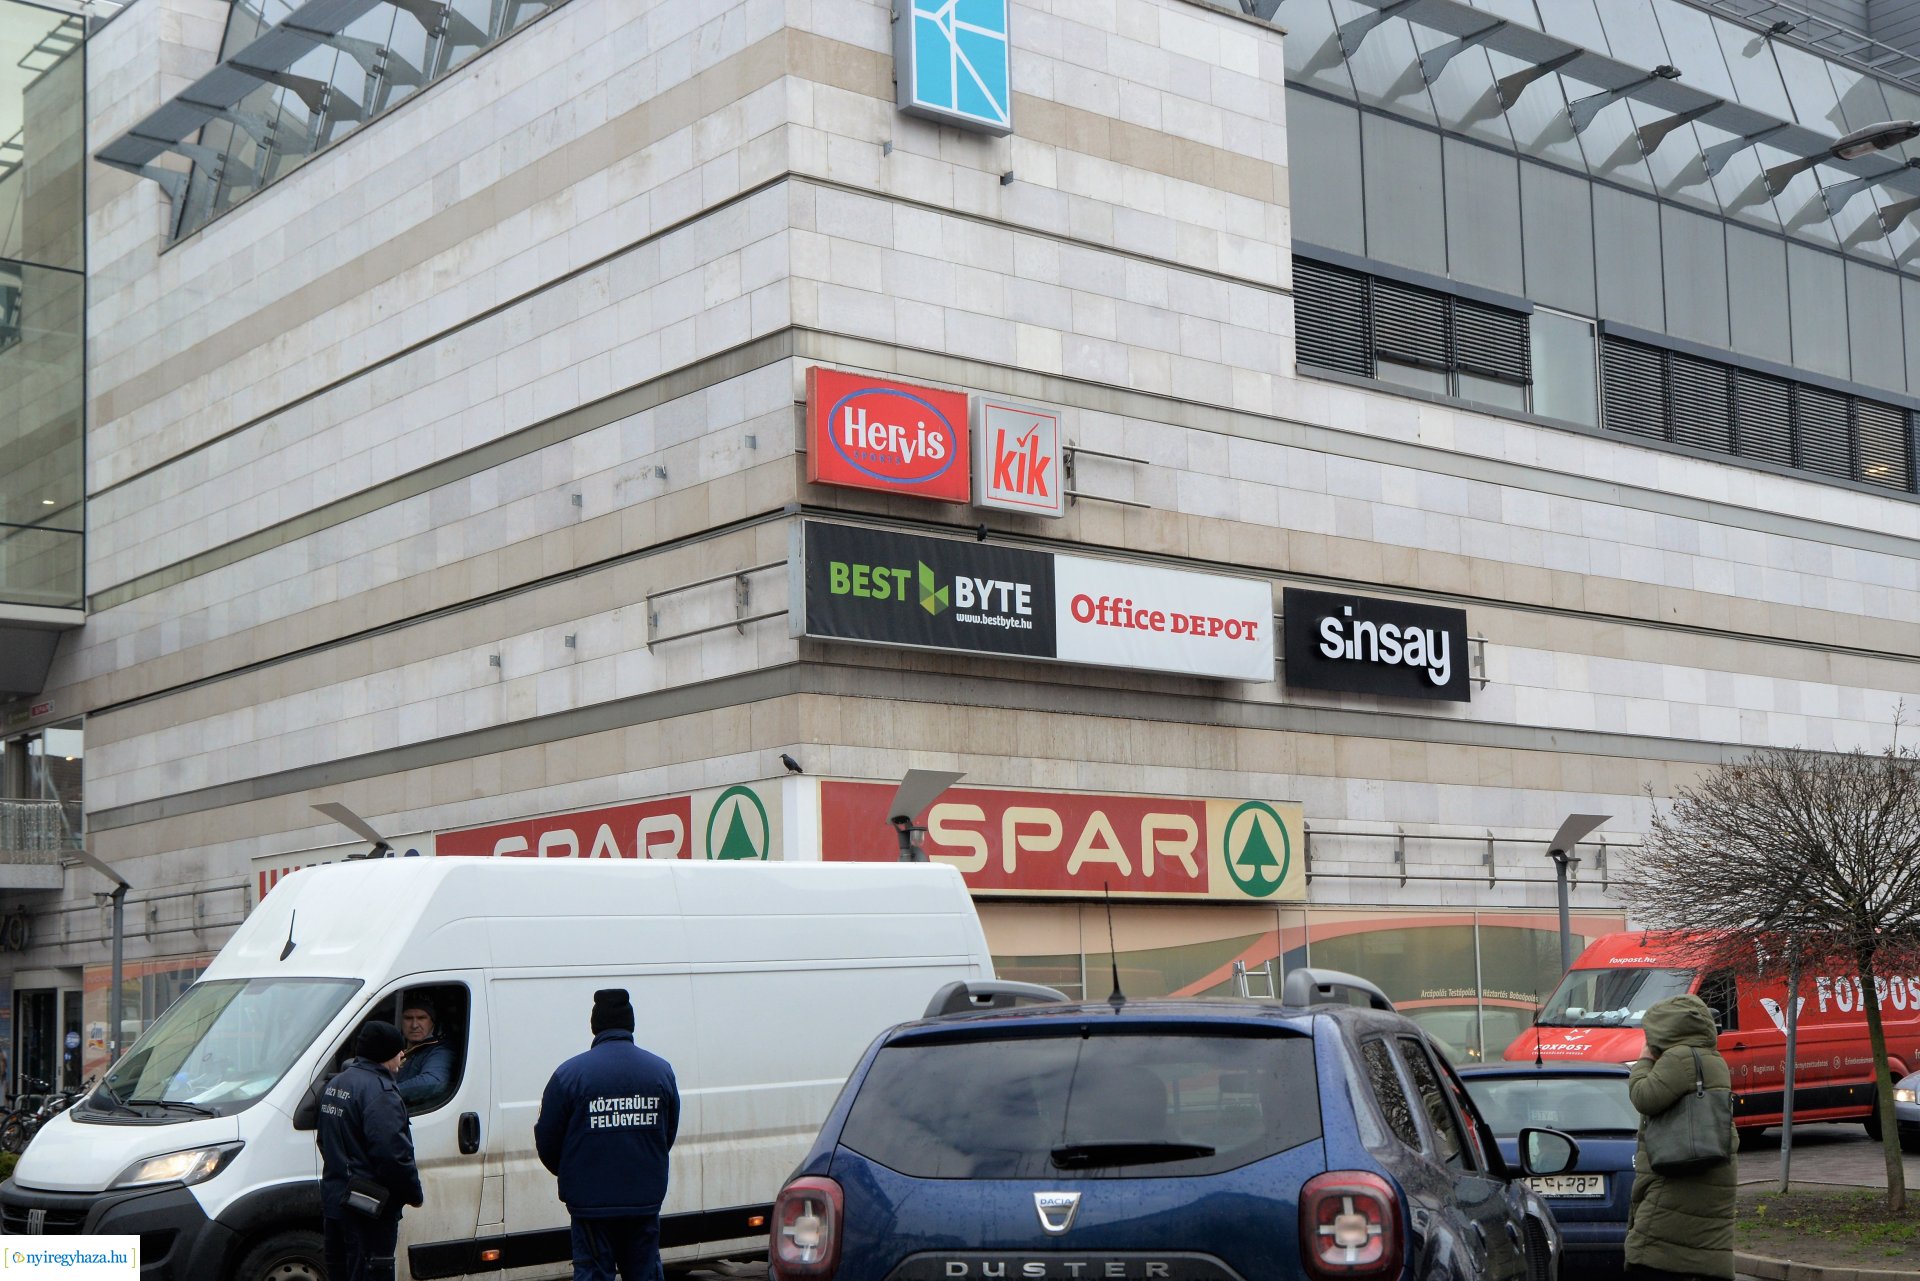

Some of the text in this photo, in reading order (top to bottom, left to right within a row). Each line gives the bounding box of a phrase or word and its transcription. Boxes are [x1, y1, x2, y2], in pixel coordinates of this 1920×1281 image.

[844, 406, 945, 463] Hervis
[853, 451, 901, 465] SPORTS
[993, 423, 1051, 497] kik
[829, 561, 1032, 615] BEST BYTE
[956, 613, 1033, 630] www.bestbyte.hu
[1070, 593, 1259, 642] Office DEPOT
[927, 802, 1200, 879] SPAR
[1608, 956, 1657, 966] foxpost.hu
[589, 1094, 660, 1113] KÖZTERÜLET
[590, 1112, 659, 1129] FELÜGYELET
[945, 1261, 1170, 1278] DUSTER
